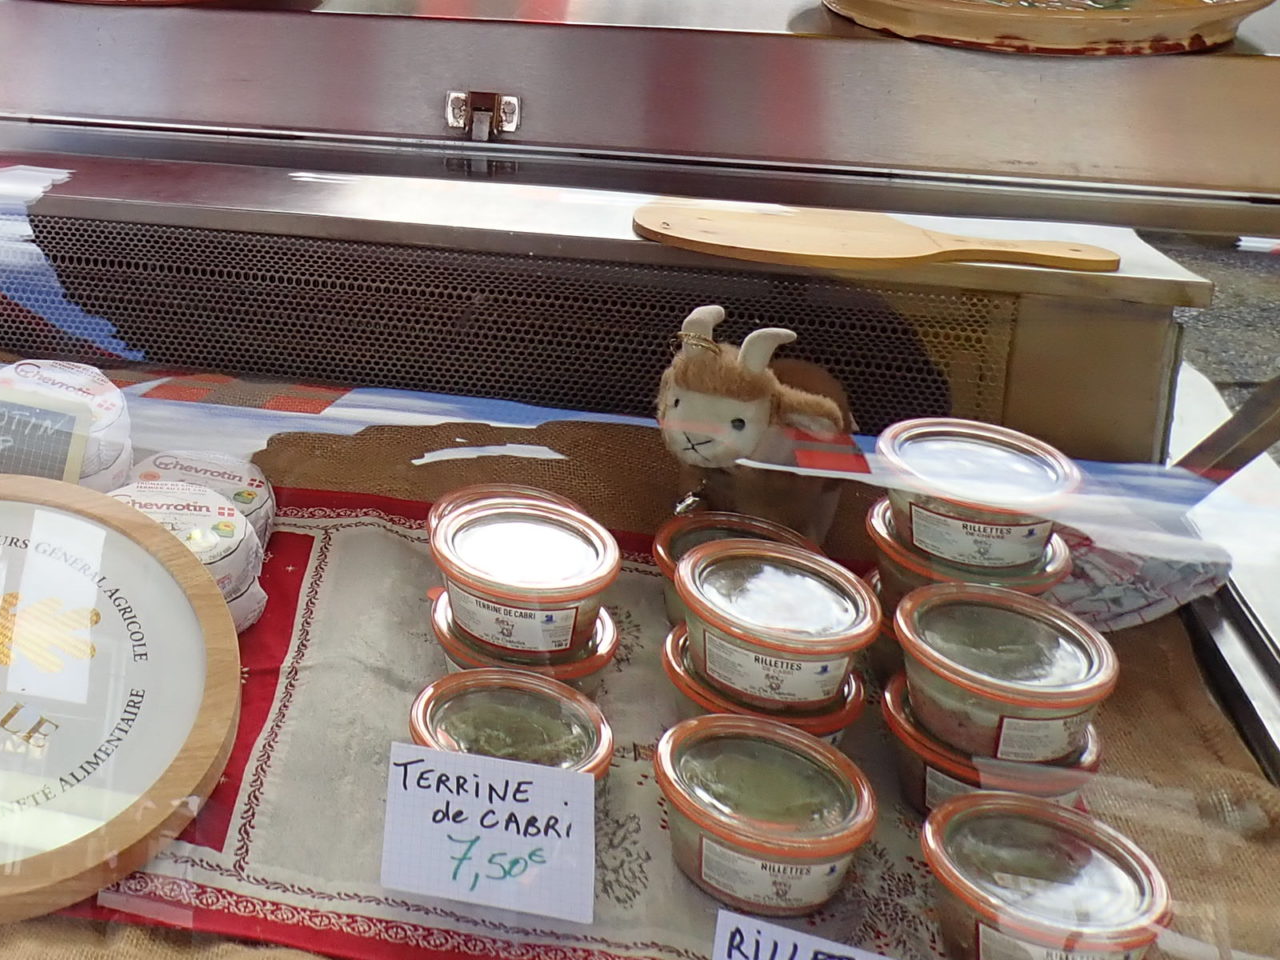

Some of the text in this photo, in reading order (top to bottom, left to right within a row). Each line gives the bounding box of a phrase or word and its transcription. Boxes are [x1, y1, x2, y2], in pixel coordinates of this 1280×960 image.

[153, 455, 243, 482] Chevrotin
[962, 523, 1012, 535] RILLETTES
[475, 600, 536, 620] TERRINE DE CABRI
[104, 588, 148, 662] AGRICOLE
[754, 655, 802, 671] RILLETTES
[58, 688, 145, 792] ALIMENTAIRE
[432, 801, 468, 823] de
[447, 834, 547, 892] 7,50€
